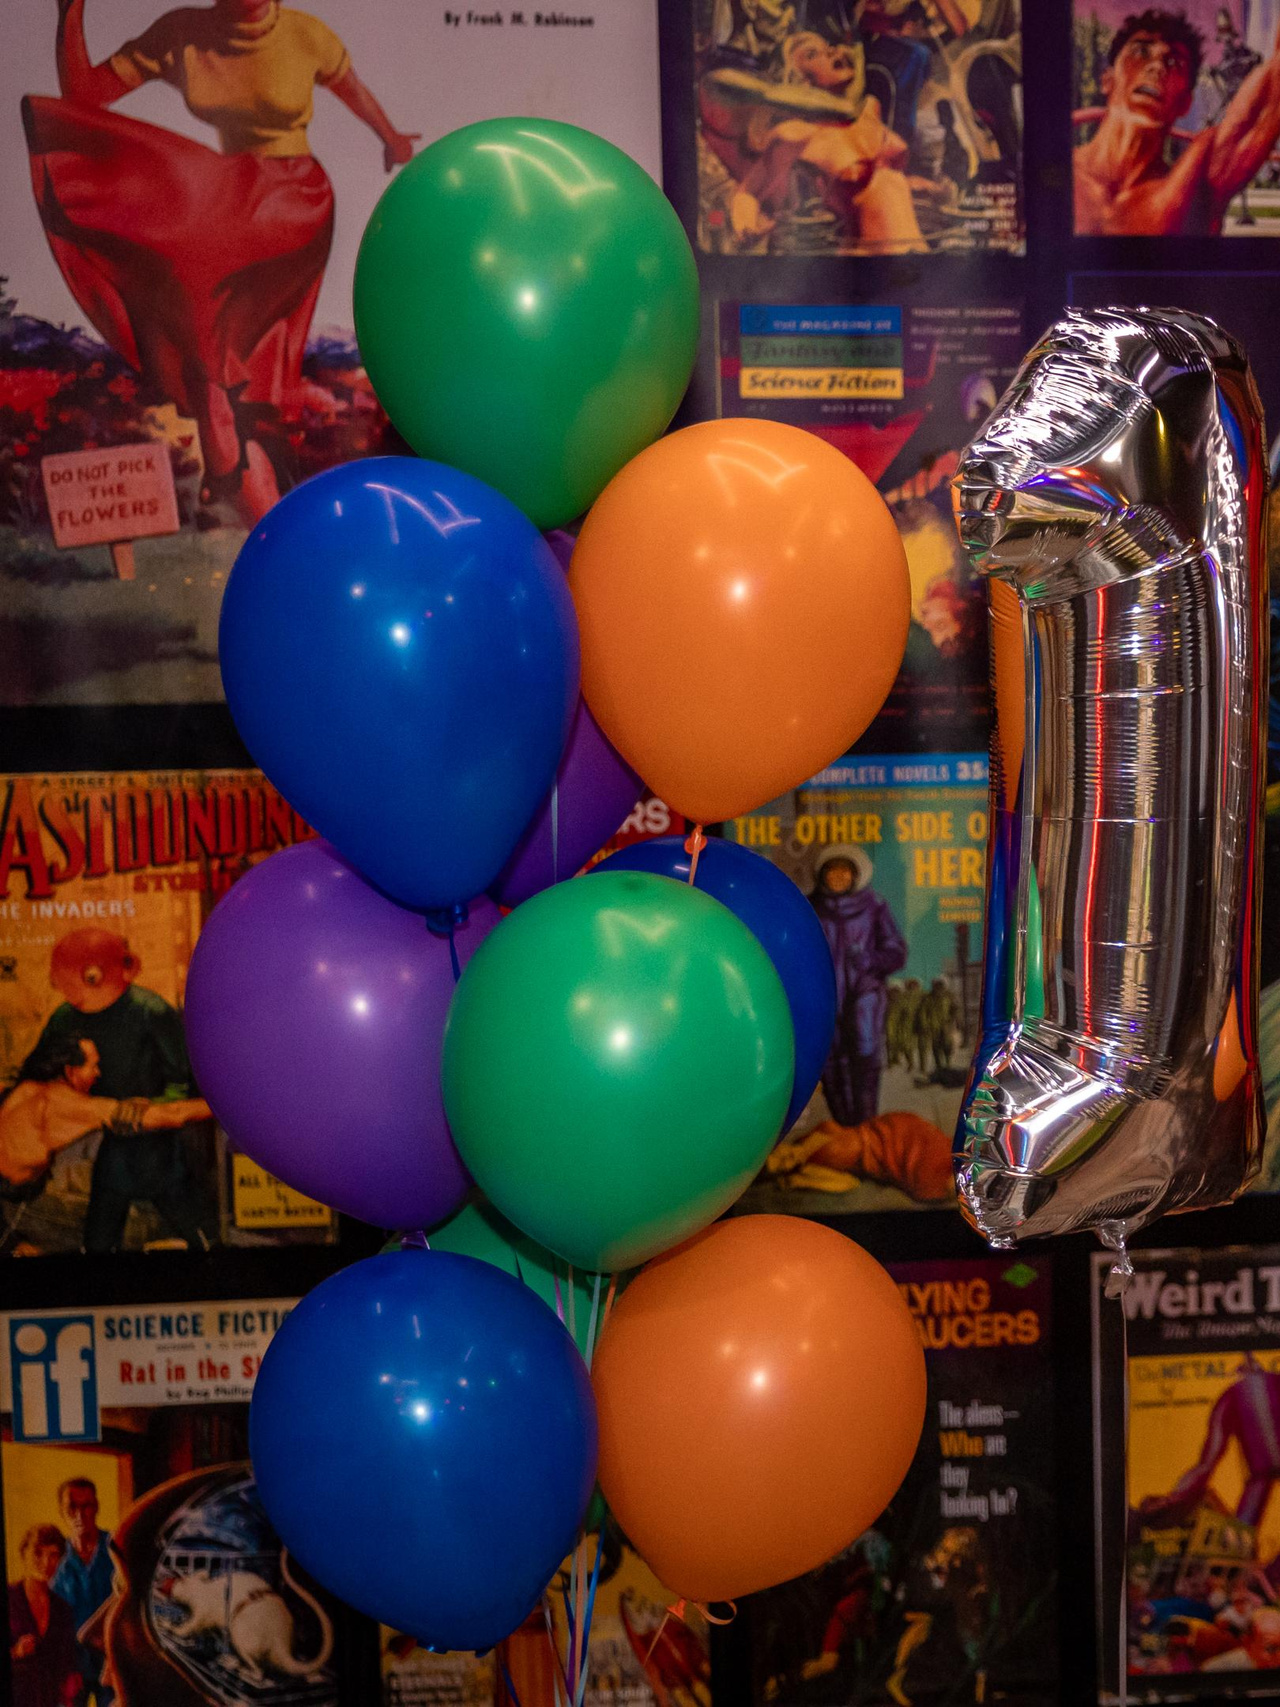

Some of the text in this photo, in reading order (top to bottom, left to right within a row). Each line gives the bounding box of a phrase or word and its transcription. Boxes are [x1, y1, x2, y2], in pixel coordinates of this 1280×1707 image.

[444, 11, 461, 26] By
[467, 11, 502, 26] Frank
[535, 12, 595, 26] Robinson
[749, 371, 897, 393] Science Fiction
[49, 456, 157, 485] DO NOT PICK
[89, 482, 128, 499] THE
[56, 497, 160, 529] FLOWERS
[892, 764, 950, 783] NOVELS
[0, 778, 322, 900] ASTOUNDIN
[733, 810, 987, 846] THE OTHER SIDE O
[914, 847, 987, 888] HER
[31, 899, 137, 918] INVADERS
[1123, 1267, 1255, 1321] Weird
[104, 1304, 293, 1341] SCIENCE FICTI
[15, 1320, 92, 1437] if
[119, 1359, 156, 1386] Rat
[166, 1356, 186, 1383] in
[197, 1355, 231, 1381] the
[939, 1399, 964, 1429] The
[939, 1430, 985, 1458] Who
[940, 1461, 970, 1494] they
